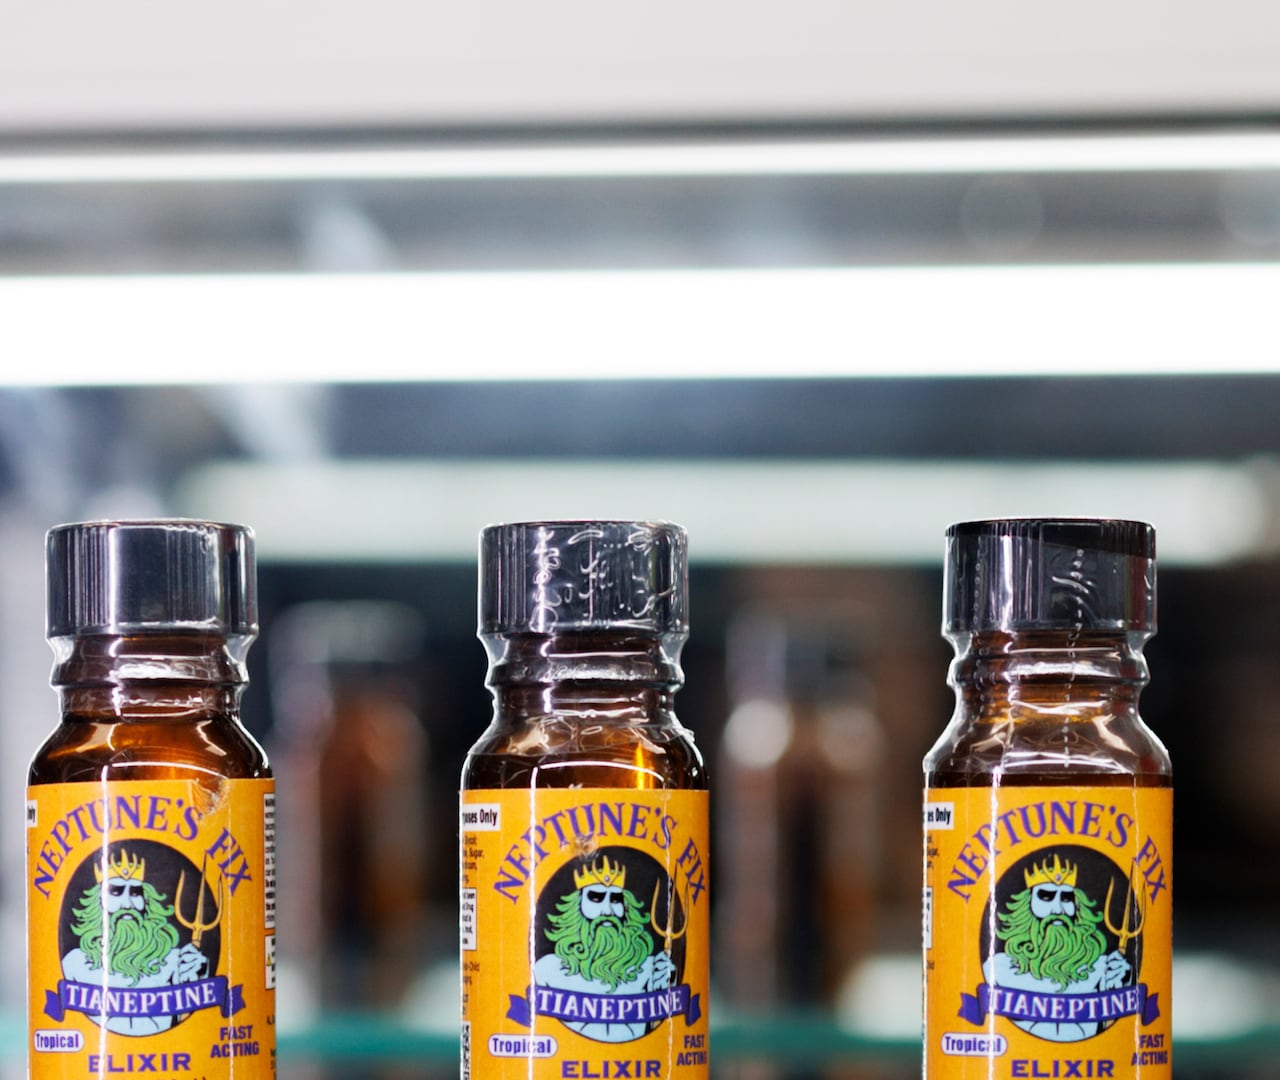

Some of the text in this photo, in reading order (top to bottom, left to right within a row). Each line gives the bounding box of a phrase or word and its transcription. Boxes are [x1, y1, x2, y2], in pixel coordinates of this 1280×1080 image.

[480, 808, 498, 827] Only
[935, 807, 952, 825] Only
[34, 795, 203, 899] NEPTUNE'S
[205, 828, 252, 896] FIX
[494, 802, 706, 904] NEPTUNE'S FIX
[947, 801, 1167, 902] NEPTUNE'S FIX
[66, 982, 216, 1014] TIANEPTINE
[537, 990, 682, 1020] TIANEPTINE
[987, 988, 1138, 1019] TIANEPTINE
[37, 1032, 79, 1050] Tropical
[220, 1025, 253, 1041] FAST
[684, 1035, 704, 1049] FAST
[1140, 1034, 1164, 1048] FAST
[210, 1042, 259, 1059] ACTING
[492, 1037, 551, 1055] Tropical
[945, 1035, 1001, 1053] Tropical
[88, 1054, 191, 1073] ELIXIR
[1131, 1050, 1168, 1066] ACTING
[561, 1061, 661, 1078] ELIXIR
[1011, 1060, 1114, 1077] ELIXIR
